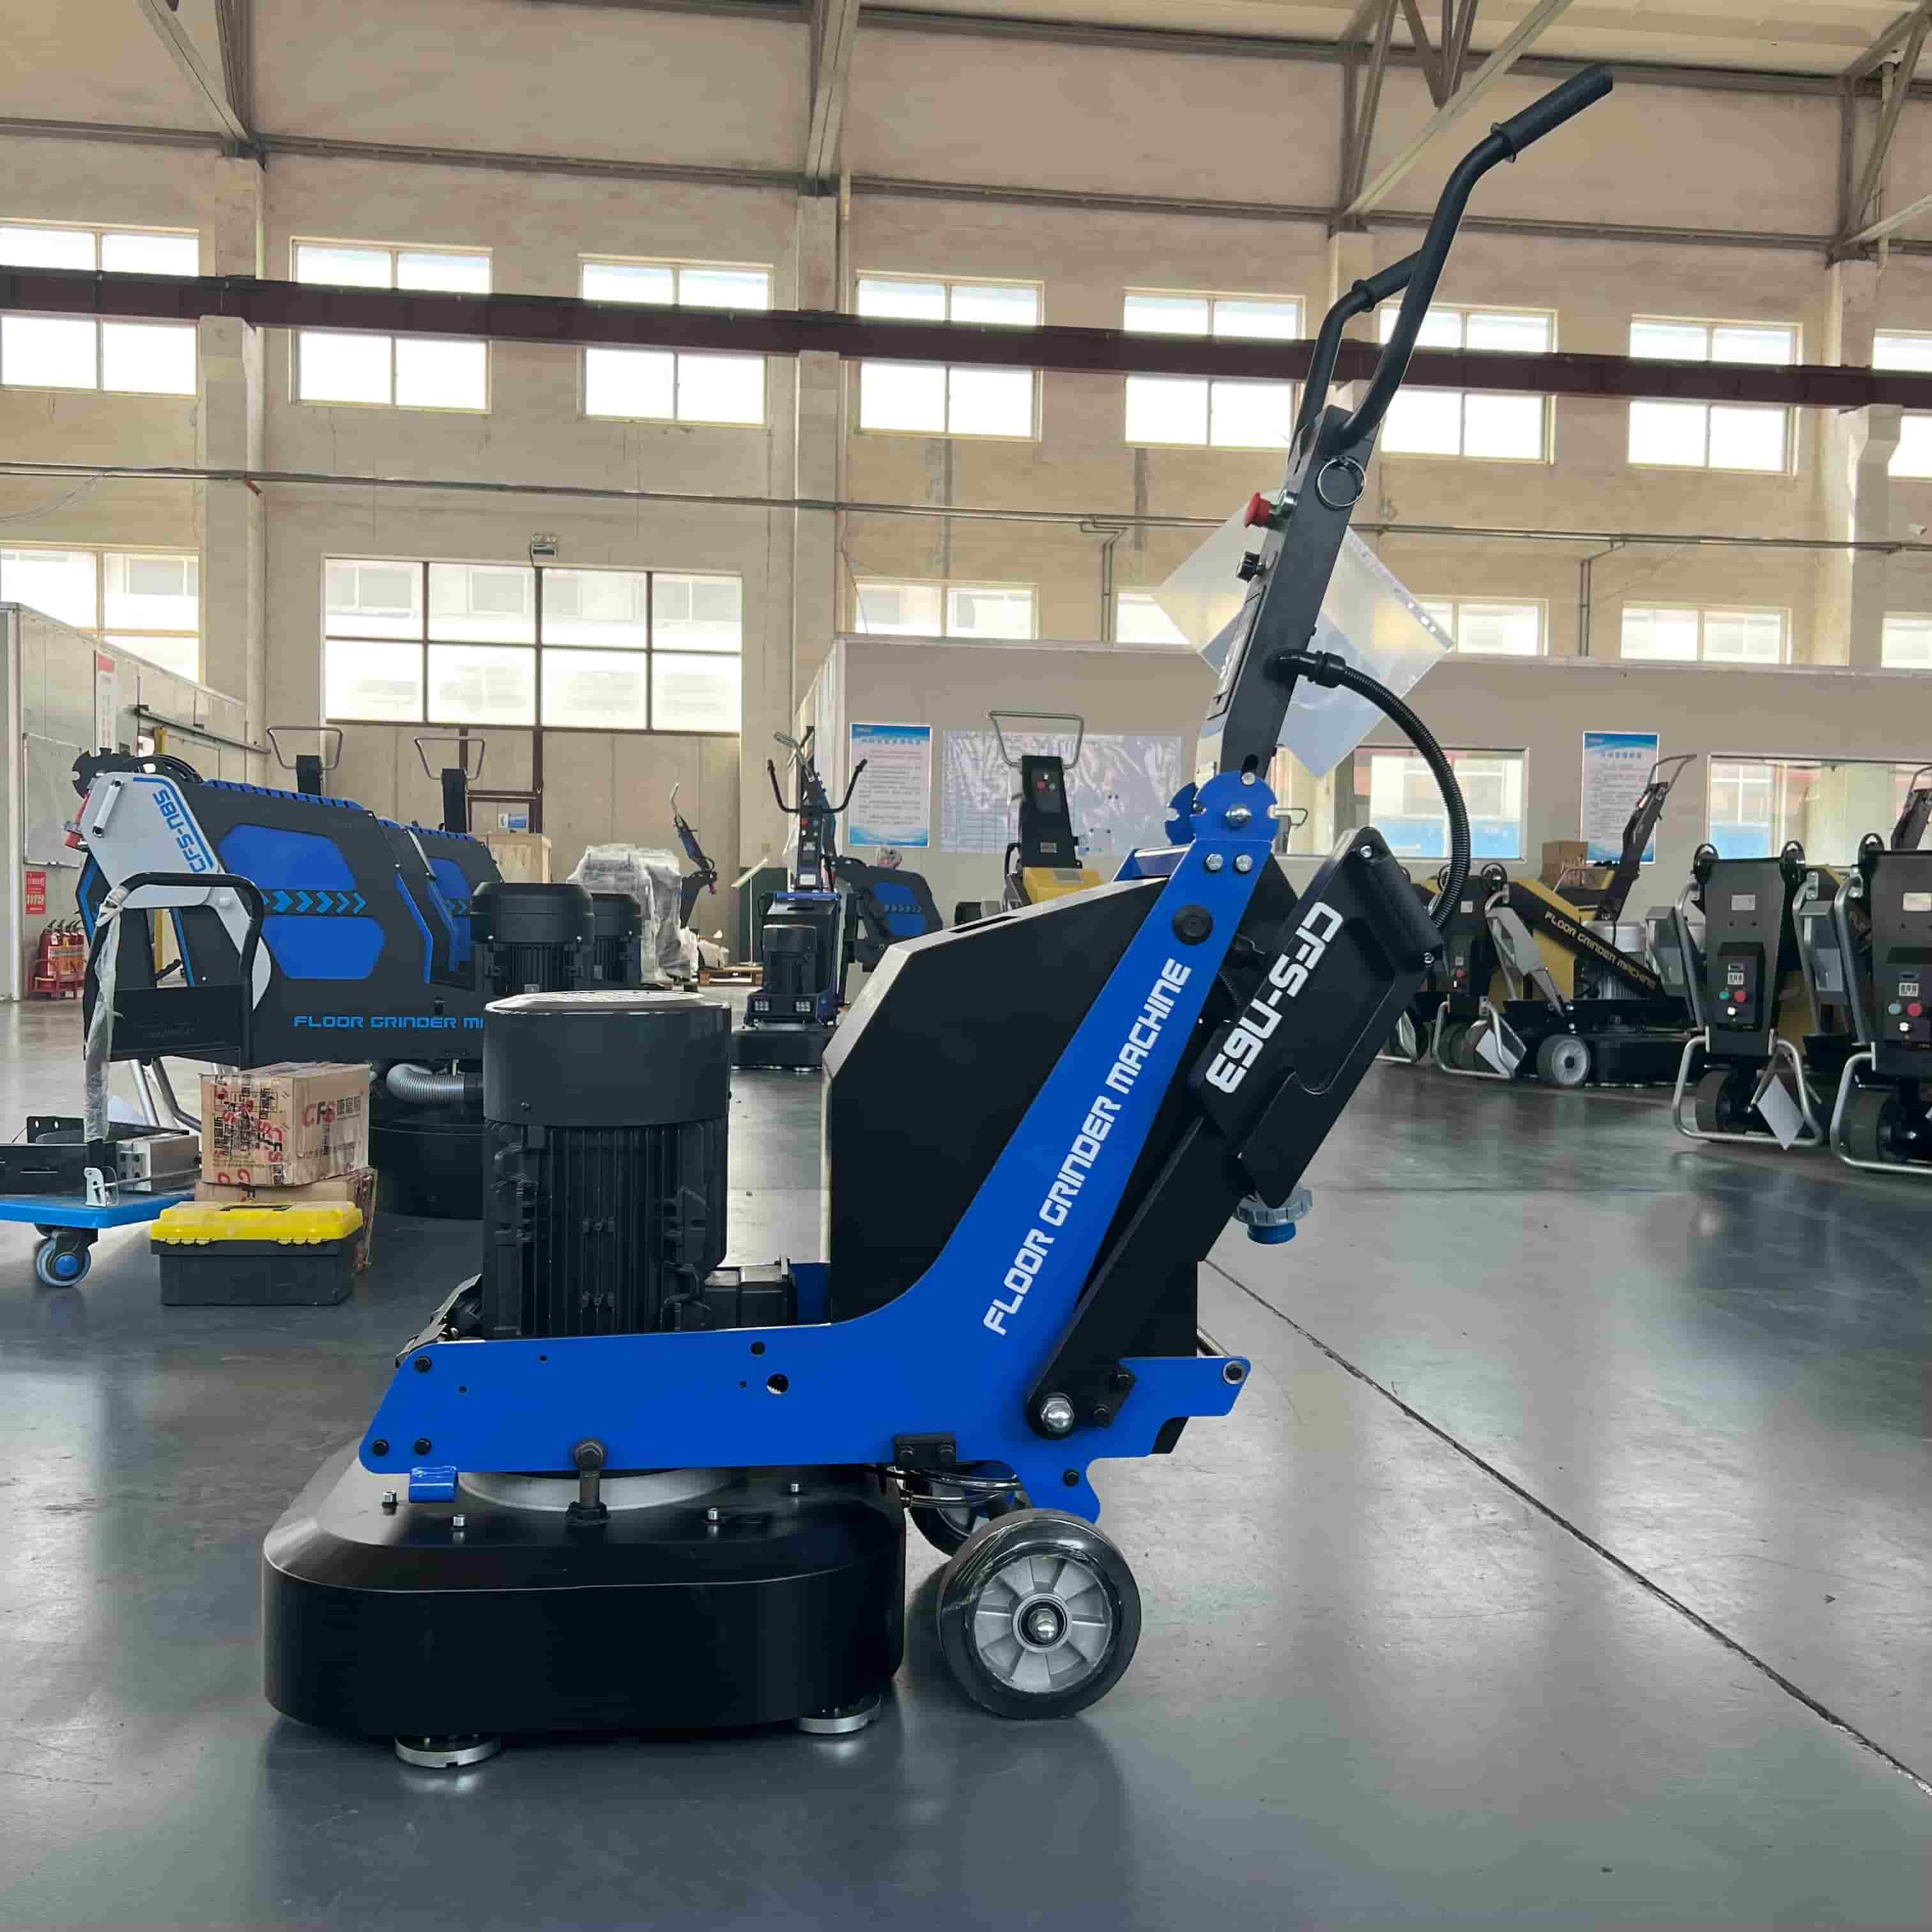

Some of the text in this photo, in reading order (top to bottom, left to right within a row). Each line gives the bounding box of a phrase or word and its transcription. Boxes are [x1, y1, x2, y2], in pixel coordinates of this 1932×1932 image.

[1544, 910, 1576, 937] FLOOR
[293, 1015, 364, 1029] FLOOR
[370, 1016, 456, 1029] GRINDER
[983, 958, 1192, 1335] FLOOR GRINDER MACHINE
